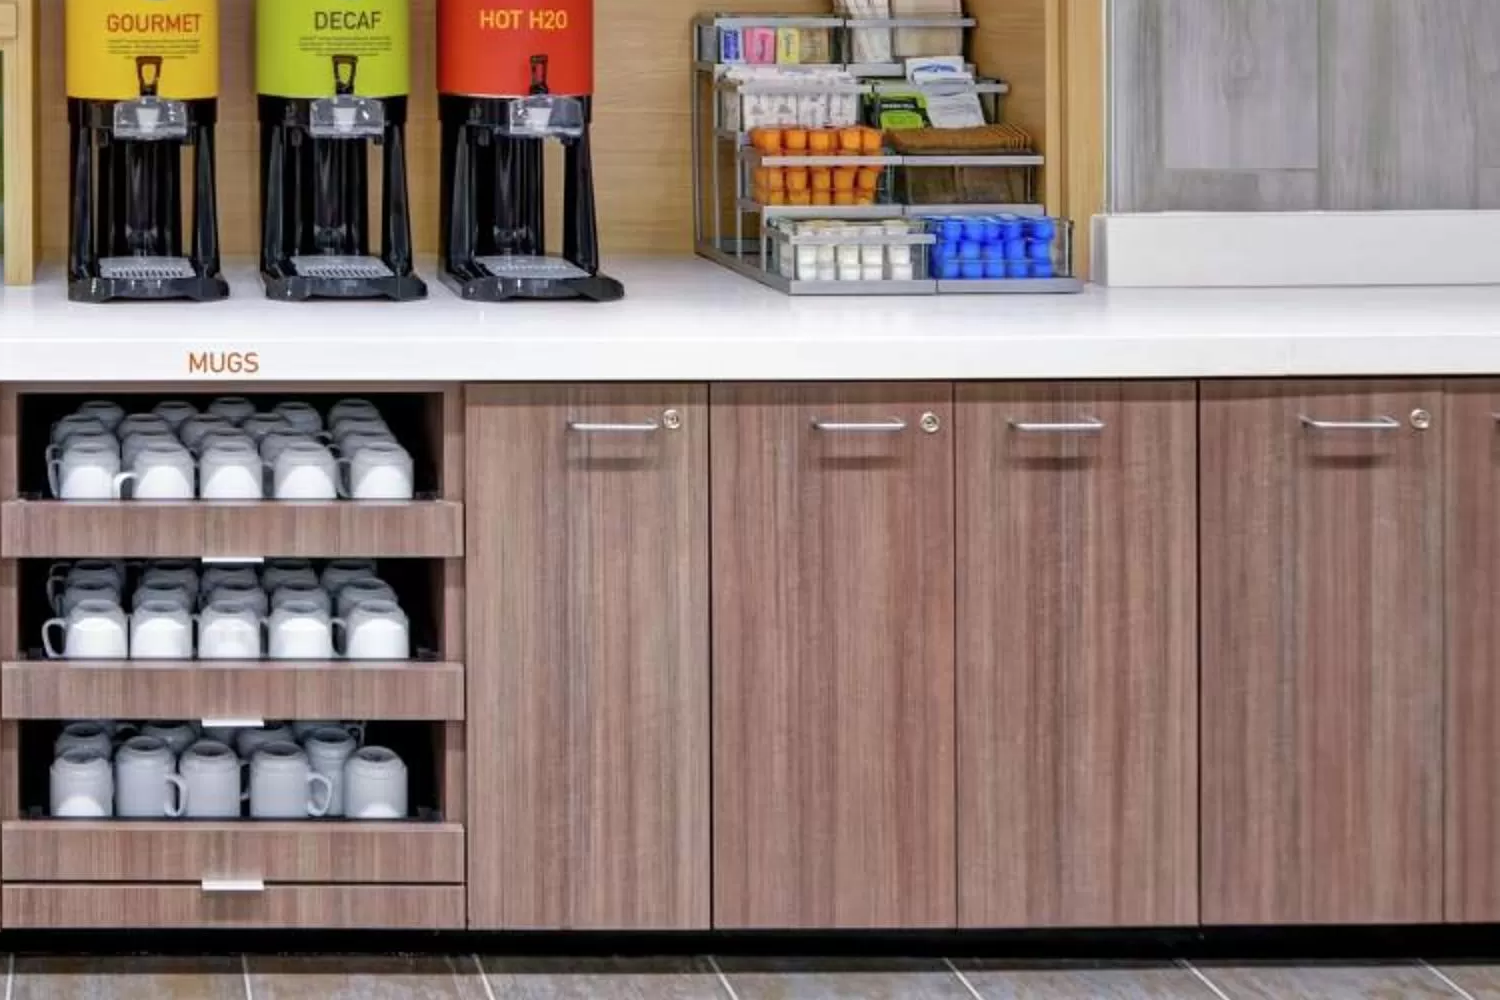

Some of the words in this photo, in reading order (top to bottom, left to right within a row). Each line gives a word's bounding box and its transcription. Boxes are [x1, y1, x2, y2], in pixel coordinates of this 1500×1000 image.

[106, 12, 202, 33] GOURMET
[313, 10, 382, 31] DECAF
[479, 9, 524, 30] HOT
[188, 351, 260, 374] MUGS
